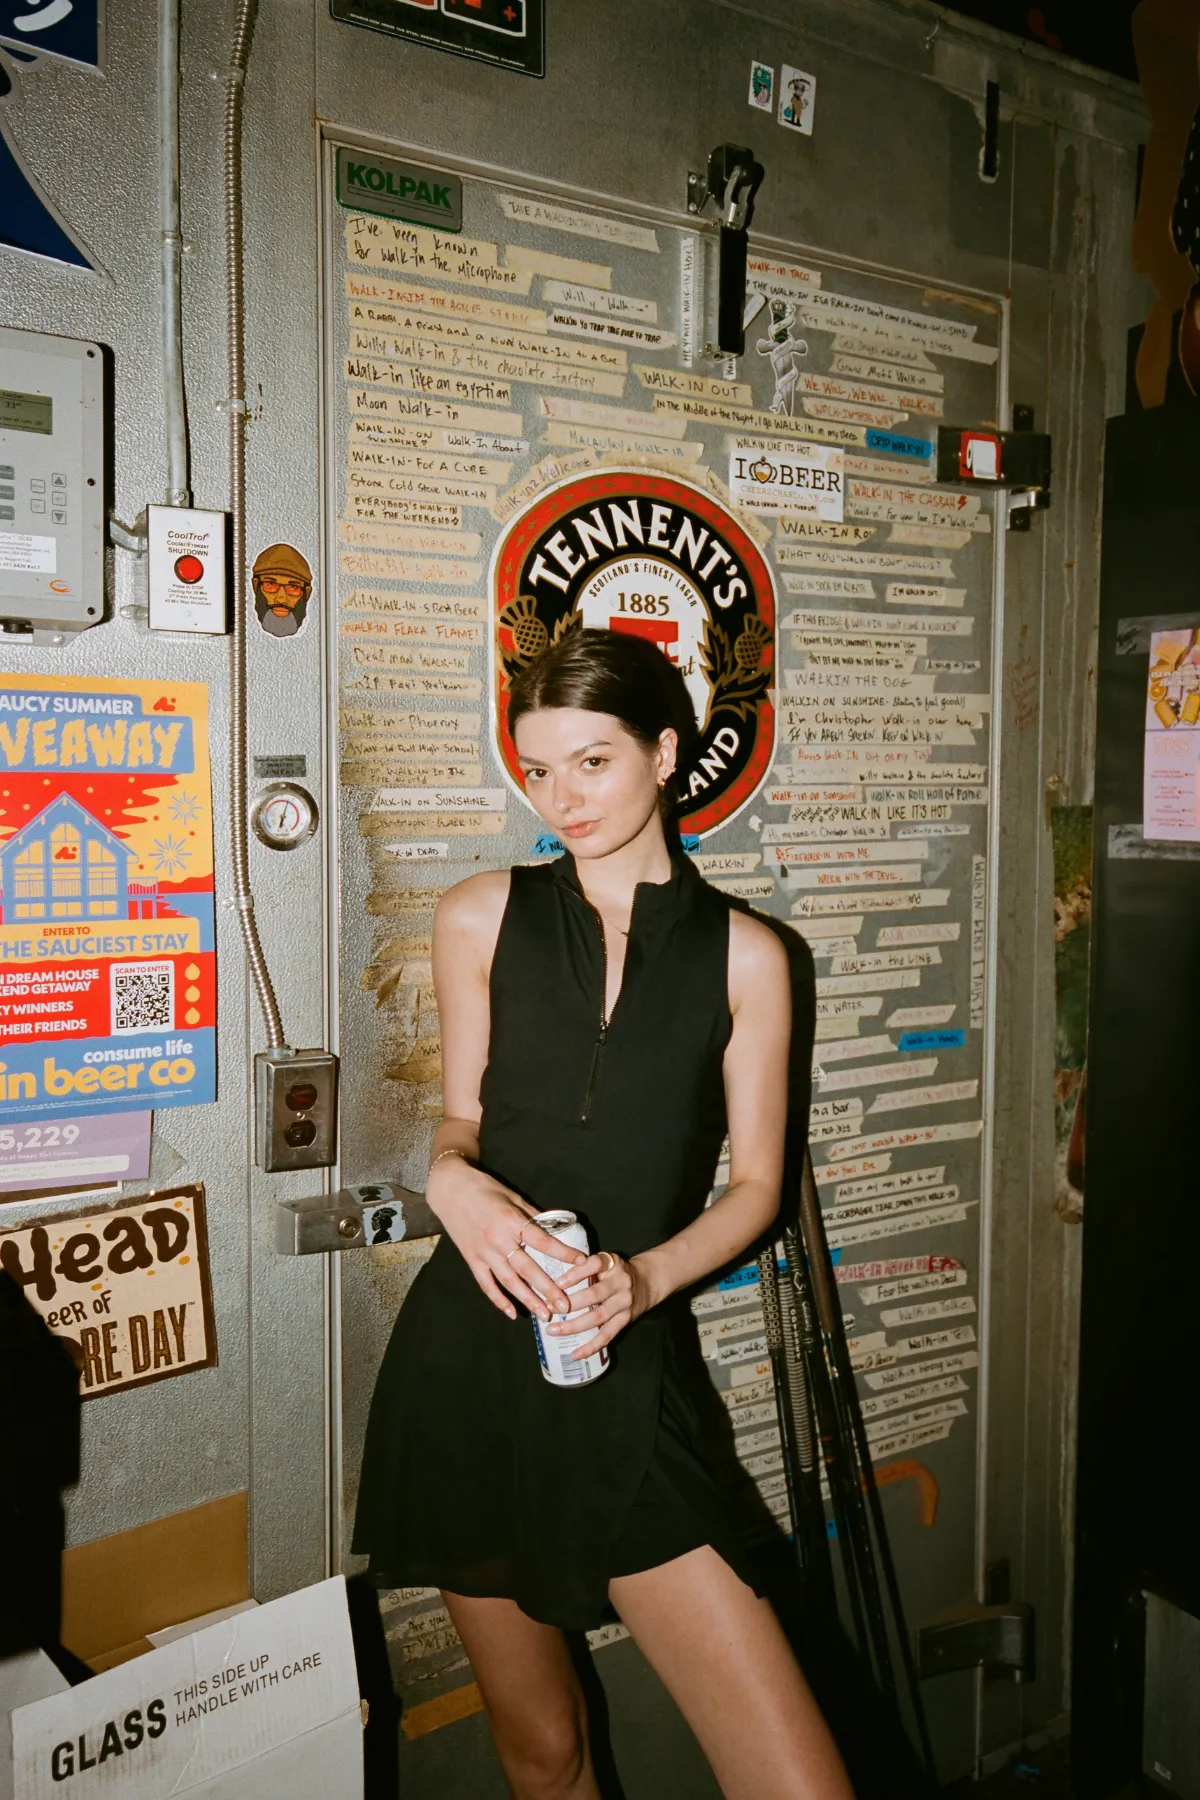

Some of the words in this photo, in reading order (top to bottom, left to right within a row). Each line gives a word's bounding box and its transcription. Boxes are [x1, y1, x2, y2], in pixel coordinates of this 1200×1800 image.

[347, 162, 452, 209] KOLPAK
[355, 240, 369, 259] for
[393, 226, 417, 245] been
[433, 234, 478, 257] known
[466, 353, 488, 370] the
[410, 367, 433, 392] like
[436, 378, 450, 390] an
[711, 384, 739, 398] OUT
[683, 403, 708, 416] Middle
[719, 409, 730, 420] the
[762, 418, 772, 430] go
[767, 443, 781, 451] LIKE
[440, 462, 448, 471] A
[735, 457, 747, 479] I
[780, 465, 841, 492] BEER
[899, 490, 916, 504] THE
[383, 511, 399, 520] THE
[168, 548, 208, 556] SHUTDOWN
[528, 499, 748, 609] TENNENT'S
[588, 562, 641, 598] SCOTLAND'S
[642, 562, 675, 583] FINEST
[674, 578, 698, 609] LAGER
[617, 591, 671, 616] 1885
[394, 622, 427, 636] FLAKA
[855, 676, 879, 686] THE
[884, 677, 912, 687] DOG
[52, 697, 133, 715] SUMMER
[0, 717, 184, 768] VEAWAY
[678, 727, 740, 802] AND
[435, 794, 490, 807] SUNSHINE
[841, 806, 881, 820] WALK-IN
[888, 806, 906, 819] LIKE
[911, 805, 927, 818] IT'S
[931, 805, 948, 817] HOT
[43, 928, 74, 936] ENTER
[0, 941, 32, 958] HE
[37, 936, 139, 956] SAUCIEST
[142, 934, 189, 950] STAY
[7, 972, 55, 984] DREAM
[56, 969, 99, 980] HOUSE
[31, 981, 91, 994] GETAWAY
[13, 1001, 74, 1015] WINNERS
[834, 1001, 864, 1013] WATER
[35, 1019, 87, 1032] FRIENDS
[83, 1044, 162, 1064] consume
[165, 1039, 193, 1055] life
[44, 1057, 144, 1096] beer
[149, 1058, 196, 1086] co
[0, 1124, 80, 1152] 5,229
[80, 1321, 122, 1388] RE
[174, 1681, 208, 1706] THIS
[211, 1664, 246, 1689] SIDE
[249, 1654, 270, 1673] UP
[176, 1687, 239, 1727] HANDLE
[241, 1674, 280, 1696] WITH
[281, 1653, 322, 1679] CARE
[51, 1699, 167, 1782] GLASS
